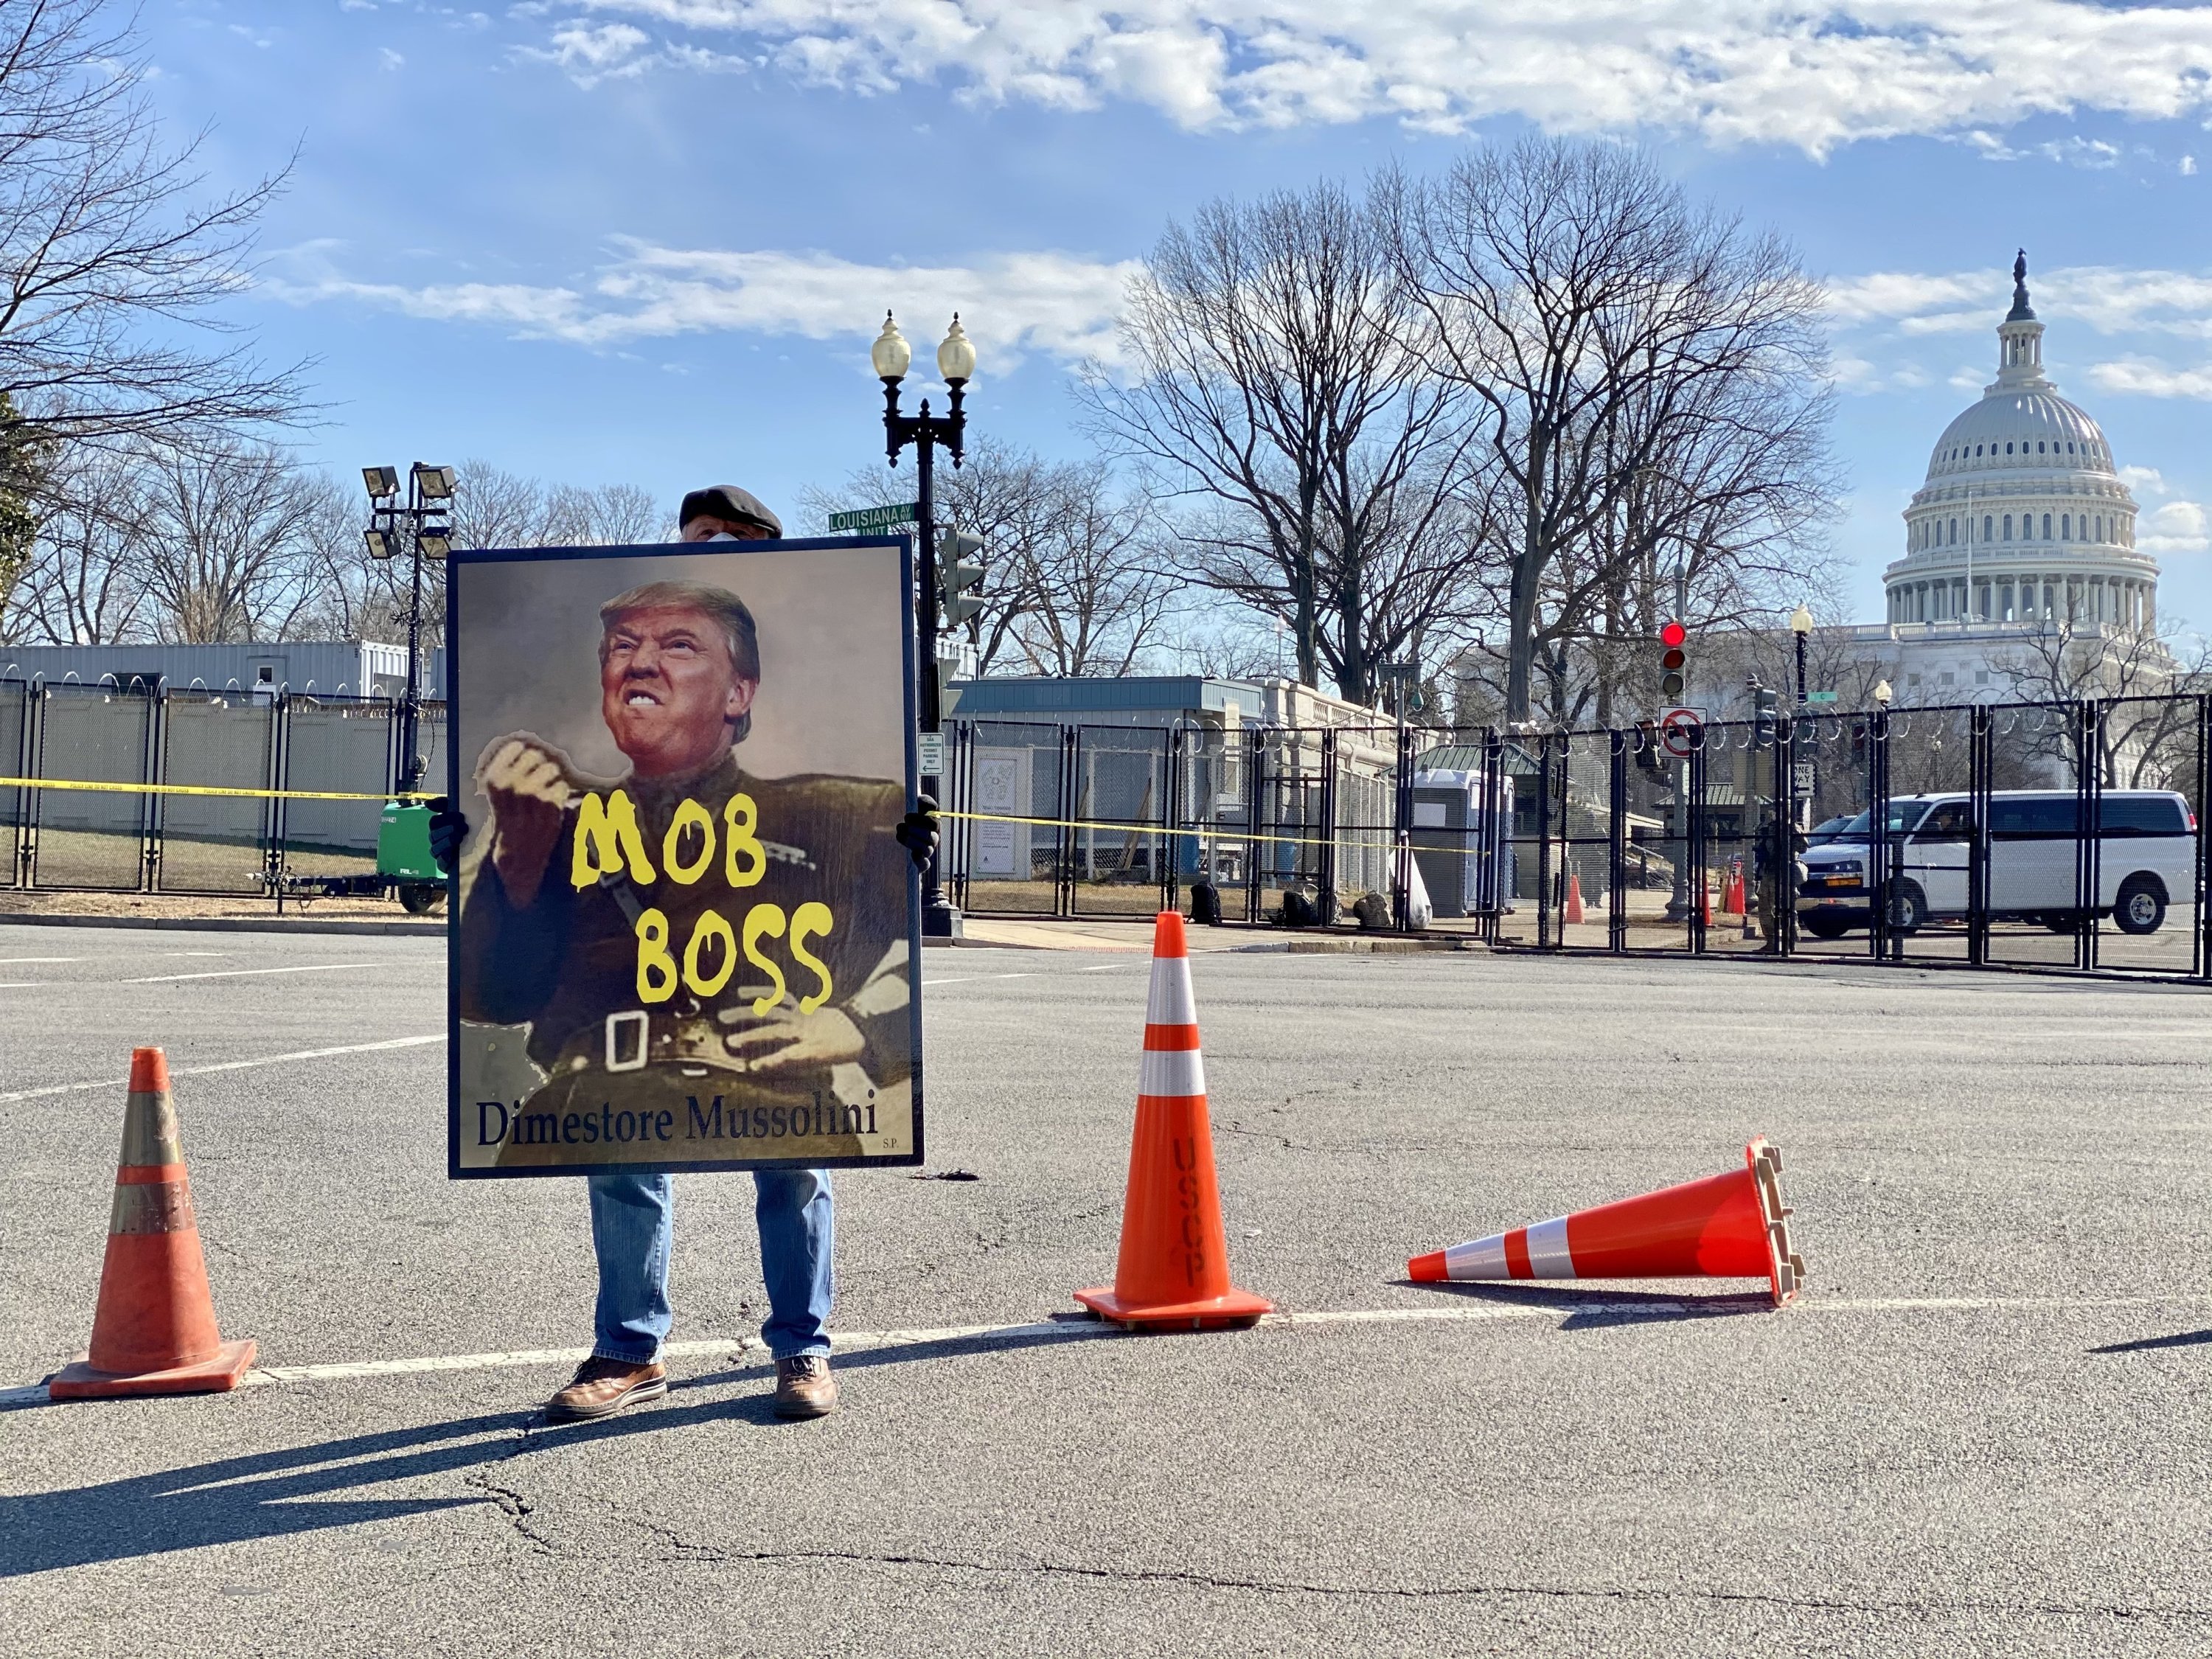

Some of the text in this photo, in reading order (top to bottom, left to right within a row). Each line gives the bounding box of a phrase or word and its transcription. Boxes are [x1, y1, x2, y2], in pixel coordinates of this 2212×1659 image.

[830, 505, 911, 530] LOUISIANA AV
[900, 512, 911, 521] NW
[571, 789, 767, 892] MOB
[636, 902, 833, 1017] BOSS
[476, 1089, 878, 1147] Dimestore Mussolini
[883, 1138, 899, 1148] S.P.
[1173, 1136, 1205, 1287] USCP
